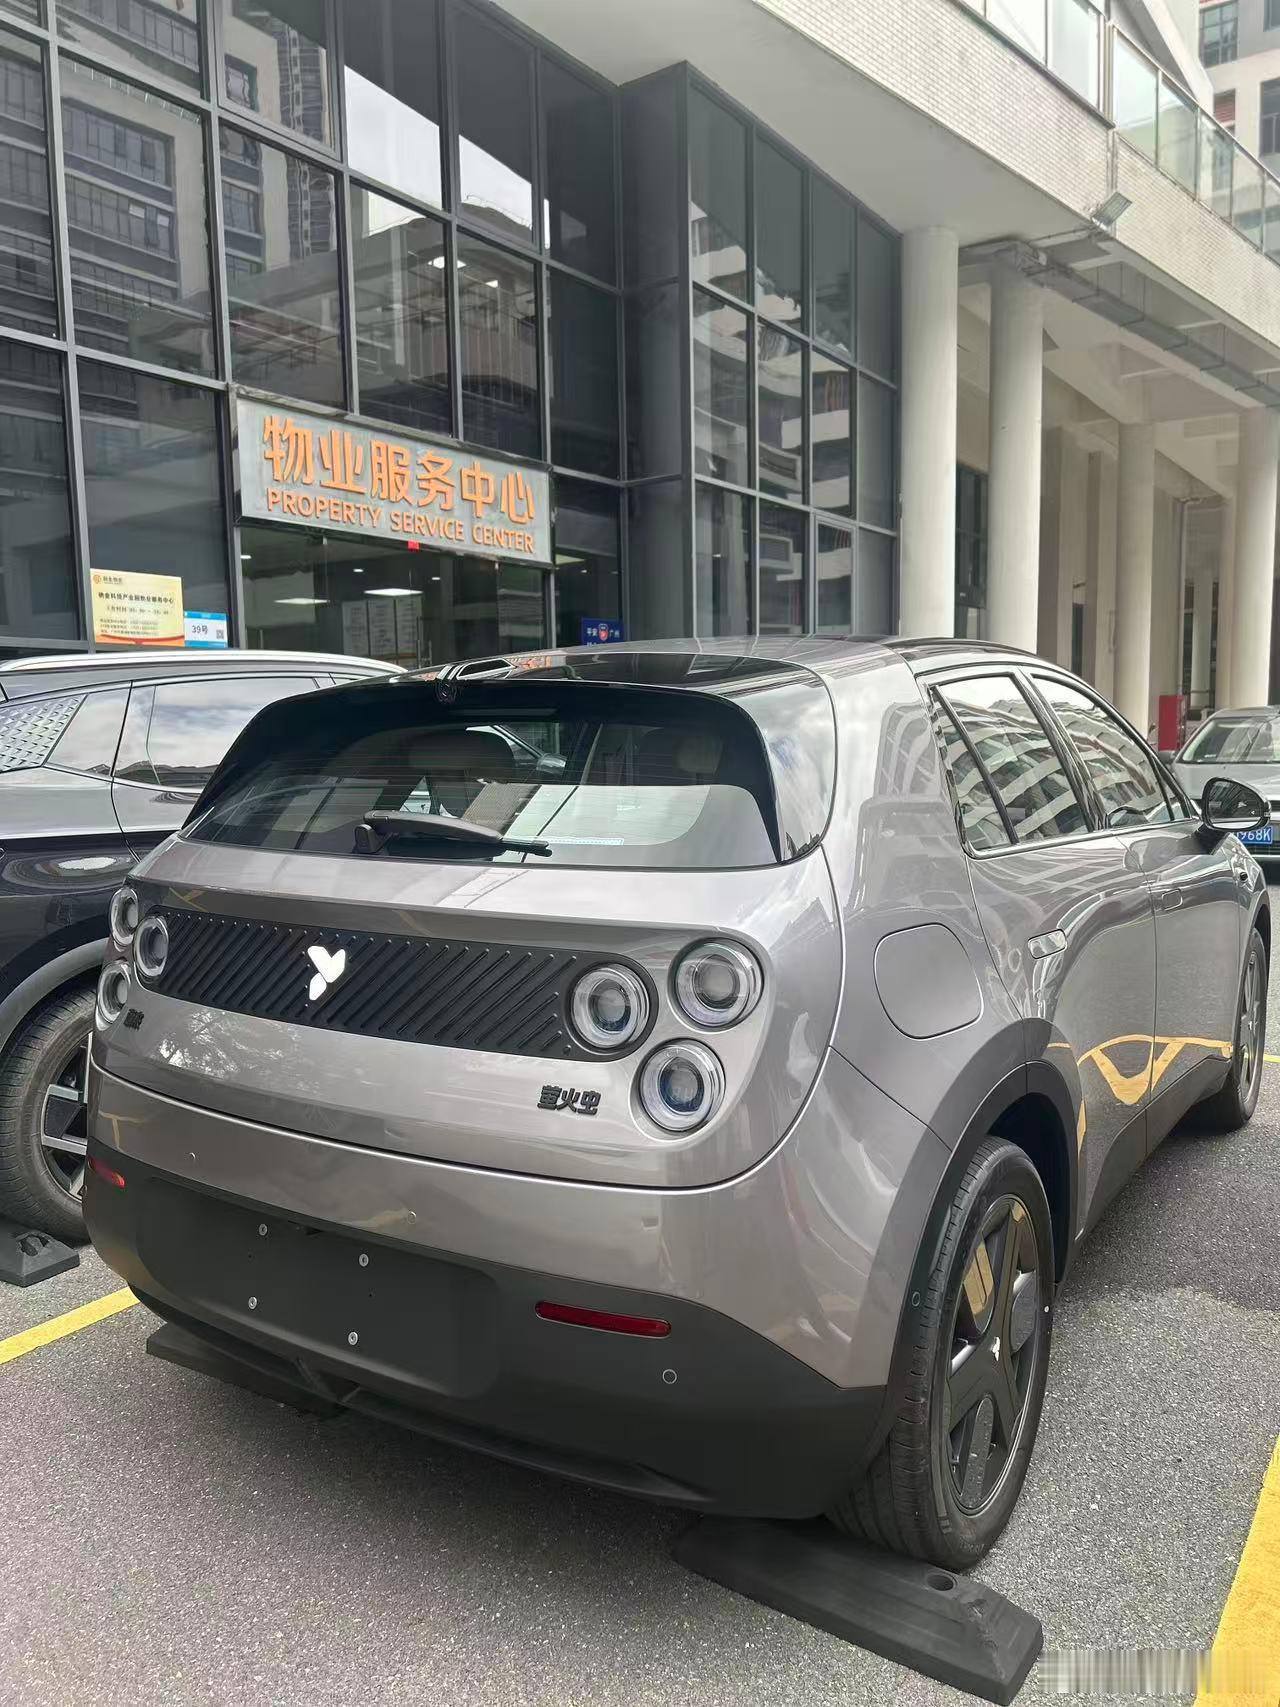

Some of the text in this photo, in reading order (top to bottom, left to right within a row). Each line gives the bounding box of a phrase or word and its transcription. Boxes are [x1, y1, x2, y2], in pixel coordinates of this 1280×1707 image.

[264, 415, 536, 524] 物业服务中心
[266, 487, 535, 554] PROPERTY SERVICE CENTER
[192, 625, 208, 634] 39号
[537, 1085, 602, 1115] 萤火虫
